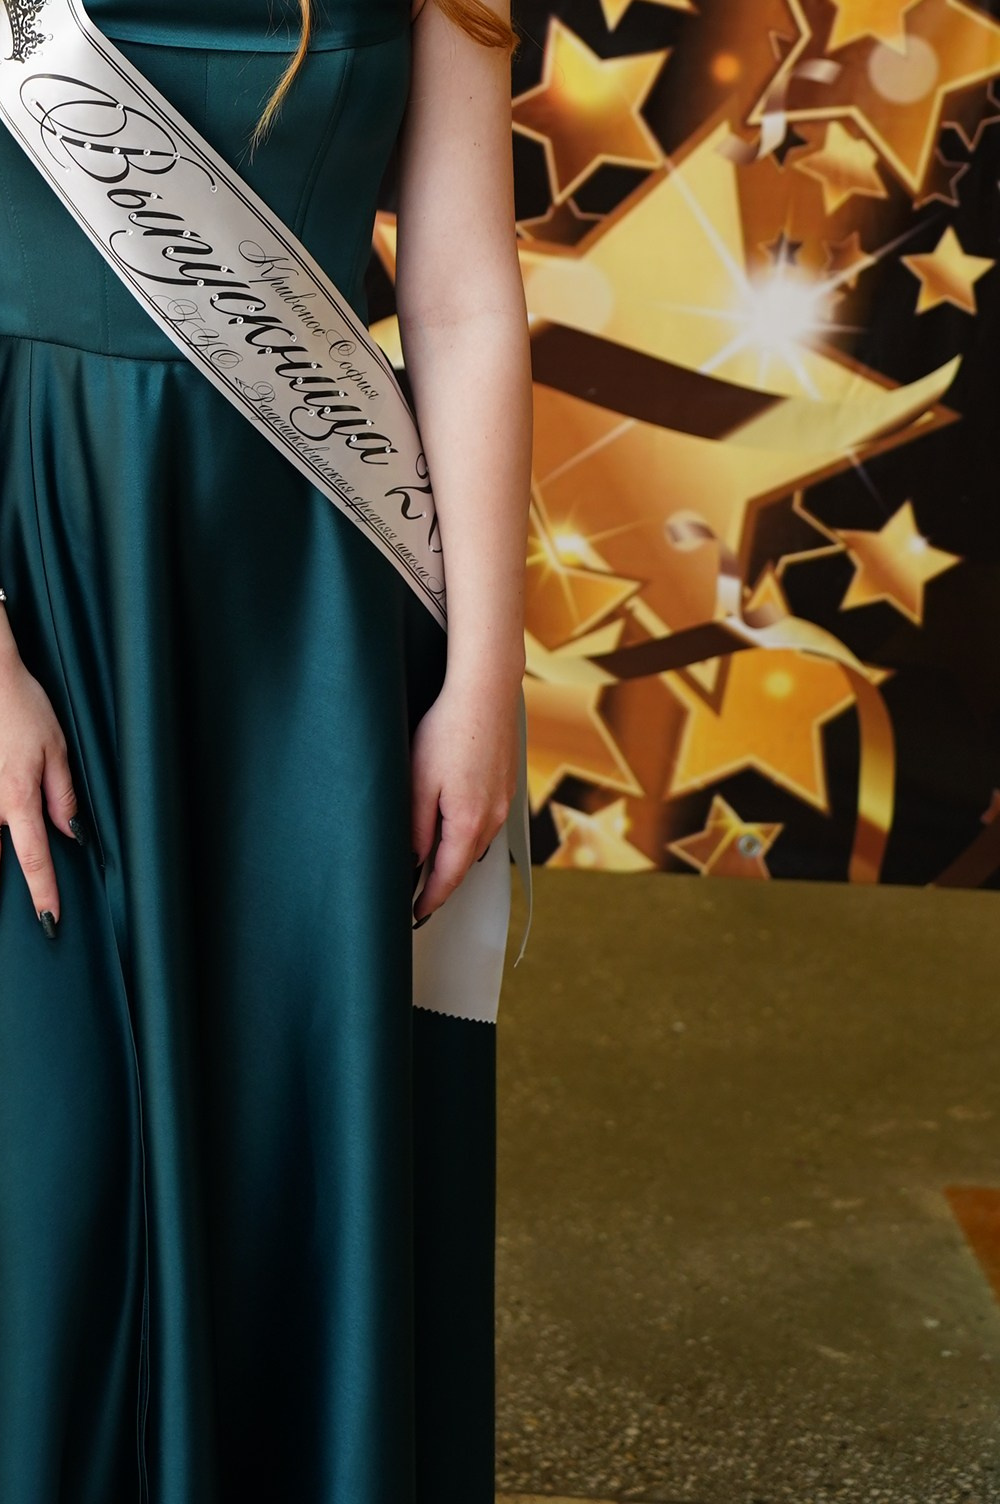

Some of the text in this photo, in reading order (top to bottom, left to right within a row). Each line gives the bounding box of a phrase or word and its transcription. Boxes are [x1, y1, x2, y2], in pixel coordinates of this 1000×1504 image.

[18, 72, 399, 465] Выпускница
[238, 239, 379, 401] Кривонос София
[346, 494, 398, 543] средняя
[396, 541, 430, 581] школа
